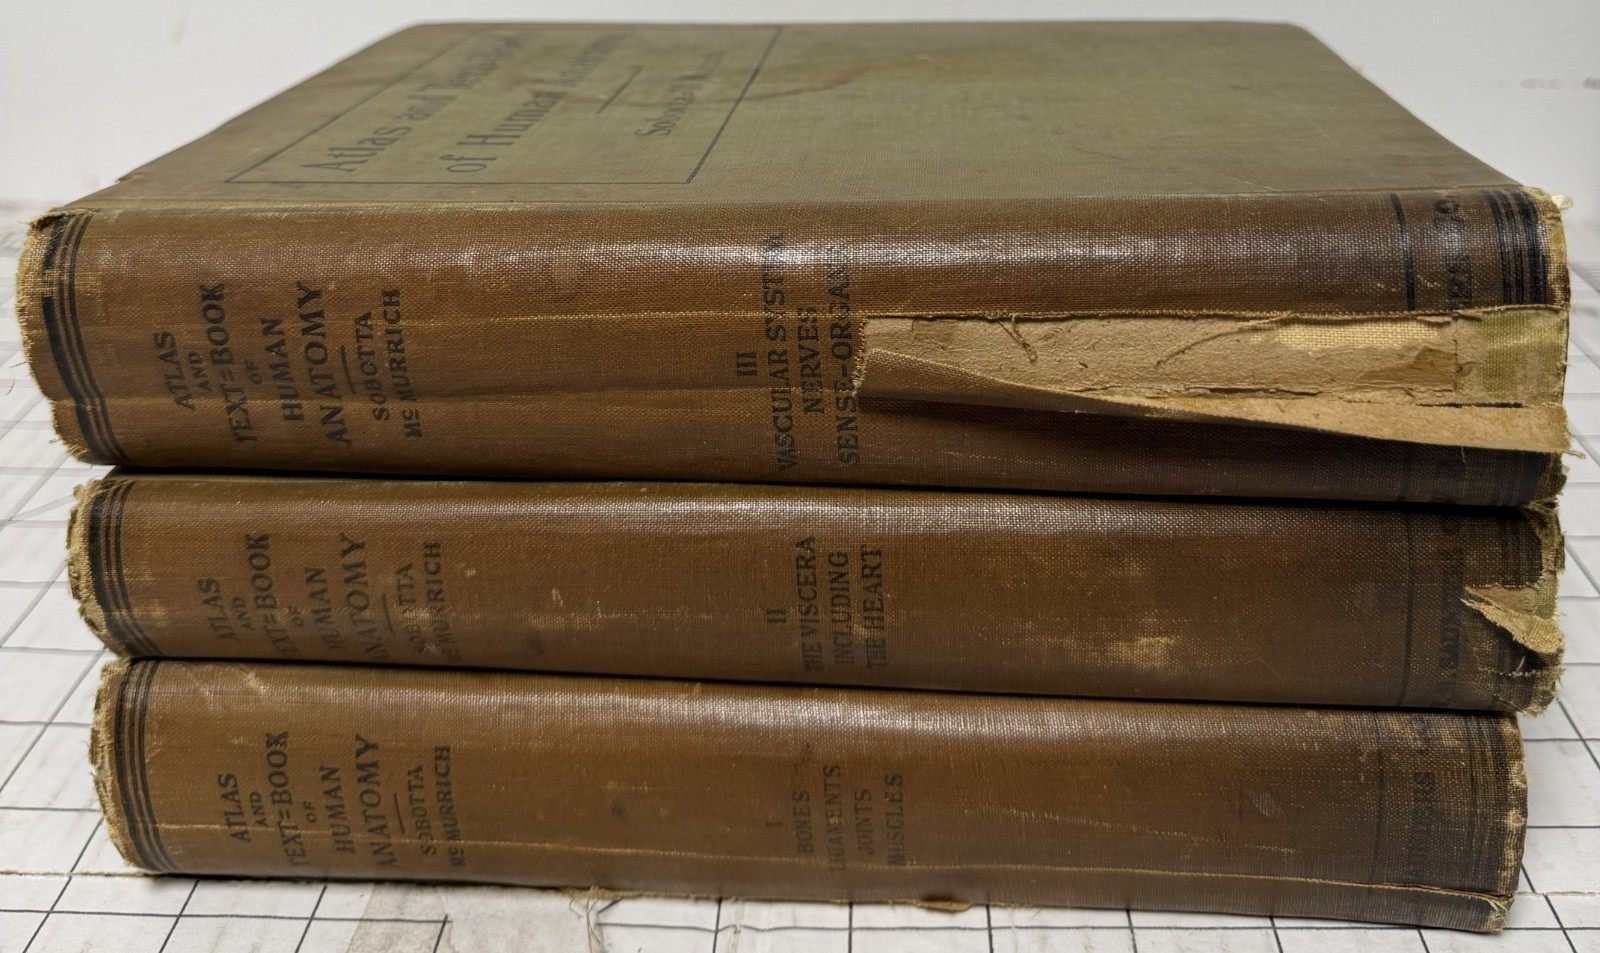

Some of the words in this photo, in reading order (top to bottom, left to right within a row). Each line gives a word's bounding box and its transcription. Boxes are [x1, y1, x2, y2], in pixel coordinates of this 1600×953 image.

[301, 126, 412, 173] Atlas
[439, 153, 498, 173] of
[153, 331, 196, 412] ATLAS
[188, 351, 212, 392] AND
[244, 359, 263, 385] OF
[260, 317, 305, 421] HUMAN
[296, 280, 352, 446] ANATOMY
[354, 311, 391, 421] SOBOTTA
[736, 352, 758, 377] III
[797, 306, 824, 415] NERVES
[768, 349, 798, 471] VASCULAR
[197, 577, 240, 643] ATLAS
[231, 596, 253, 631] AND
[288, 604, 305, 629] OF
[304, 566, 348, 652] HUMAN
[340, 532, 392, 662] ANATOMY
[766, 608, 787, 624] II
[796, 536, 819, 637] VISCERA
[828, 551, 854, 665] INCLUDING
[860, 544, 884, 631] HEART
[802, 642, 825, 672] THE
[865, 638, 888, 669] THE
[217, 772, 252, 843] ATLAS
[249, 791, 269, 828] AND
[302, 801, 318, 824] OF
[320, 765, 356, 853] HUMAN
[355, 734, 398, 869] ANATOMY
[406, 764, 437, 856] SOBOTTA
[792, 790, 814, 853] BONES
[823, 764, 846, 870] LIGAMENTS
[854, 789, 875, 855] JOINTS
[884, 773, 906, 866] MUSCLES
